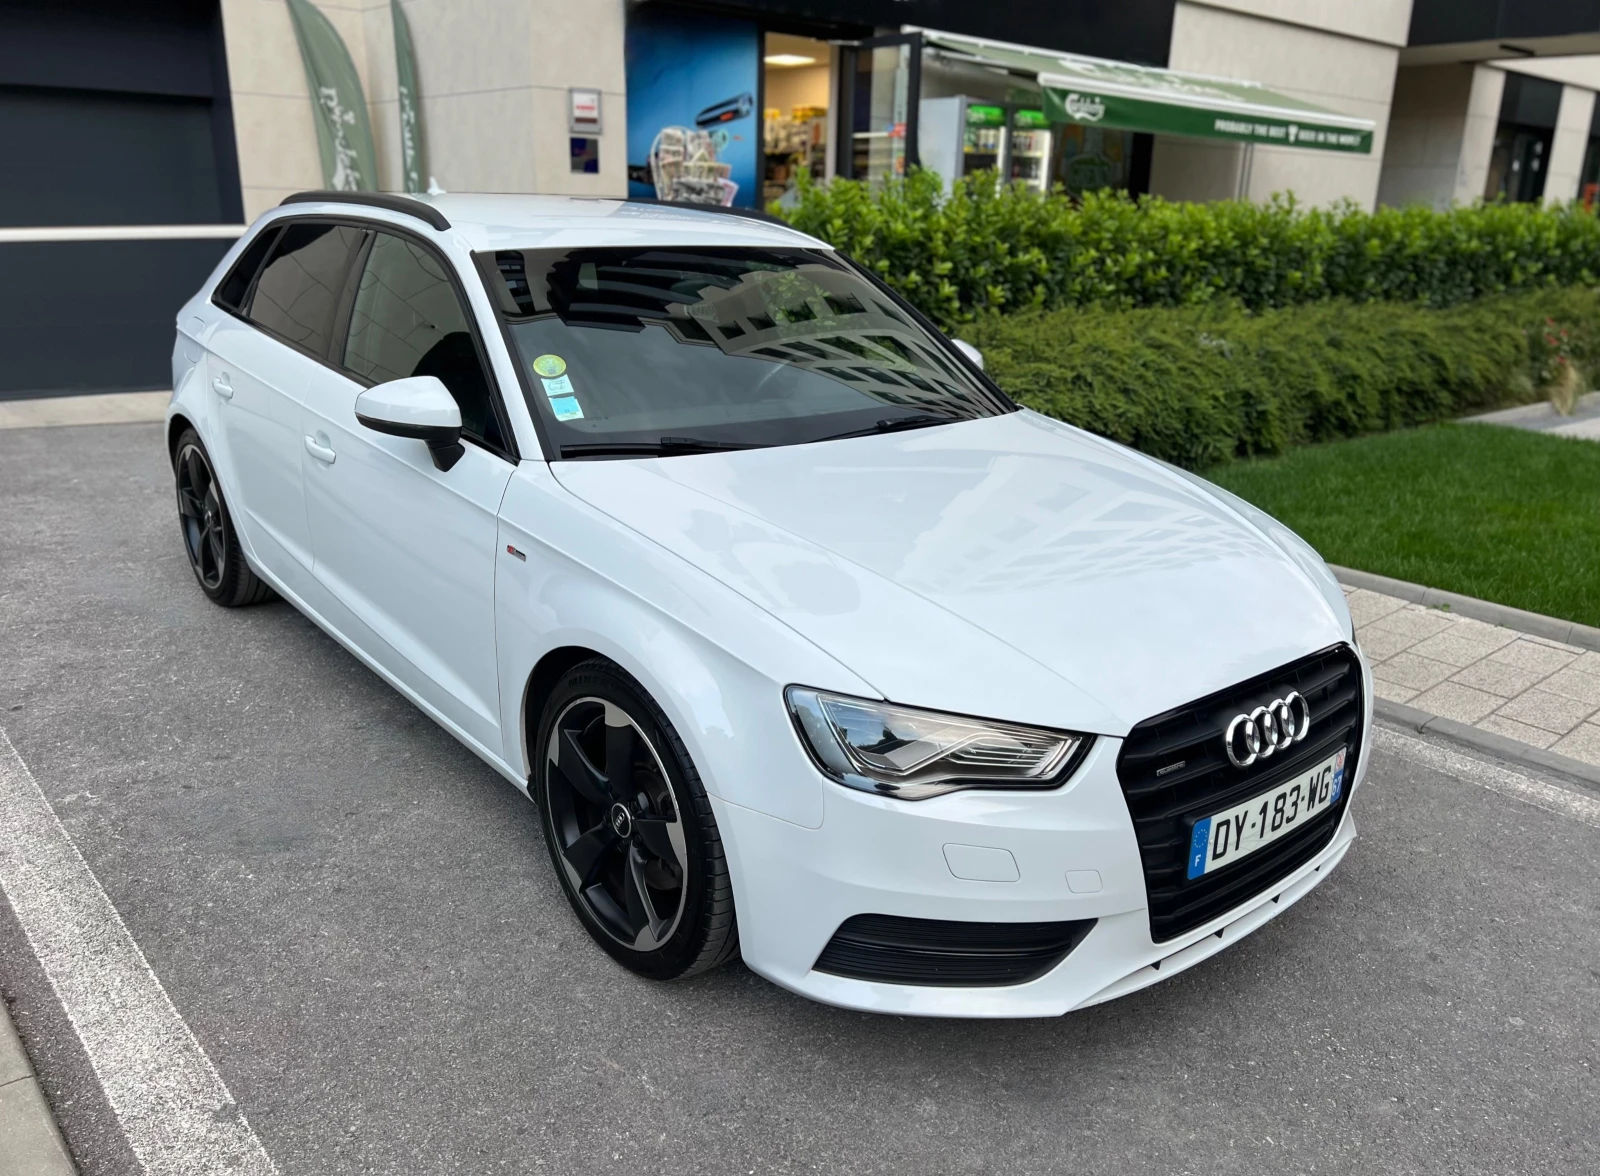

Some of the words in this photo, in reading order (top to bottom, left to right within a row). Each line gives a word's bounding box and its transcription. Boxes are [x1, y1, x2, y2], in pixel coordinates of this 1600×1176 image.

[1331, 774, 1343, 796] 67
[1212, 765, 1332, 861] DY-183-WG
[1194, 854, 1202, 867] F
